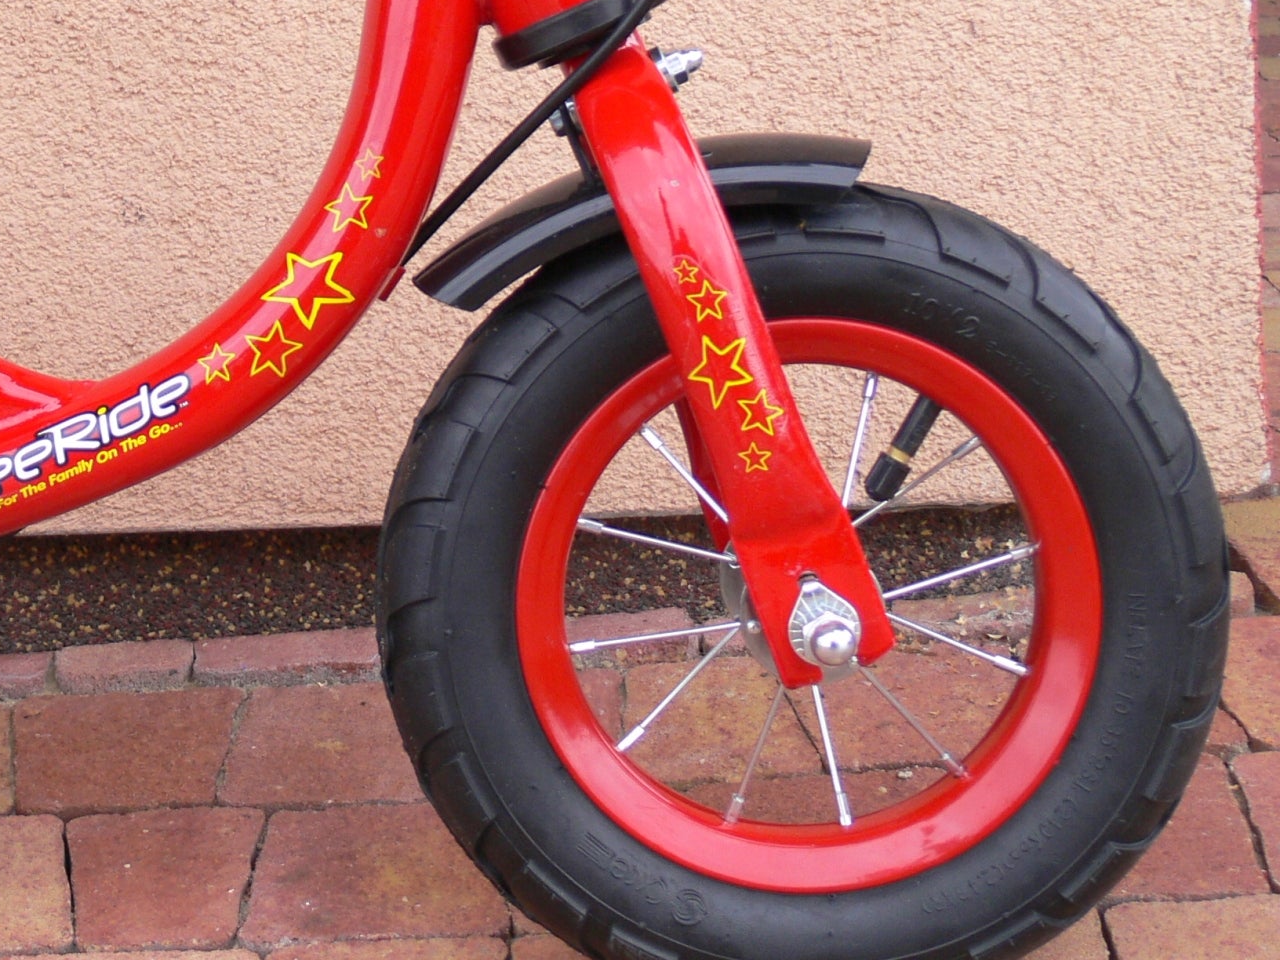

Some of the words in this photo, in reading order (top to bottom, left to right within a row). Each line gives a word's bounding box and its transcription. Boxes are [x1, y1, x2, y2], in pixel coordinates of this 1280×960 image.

[19, 481, 47, 499] The
[48, 458, 95, 487] Family
[96, 448, 119, 464] On
[119, 437, 147, 454] The
[148, 422, 183, 439] Go...
